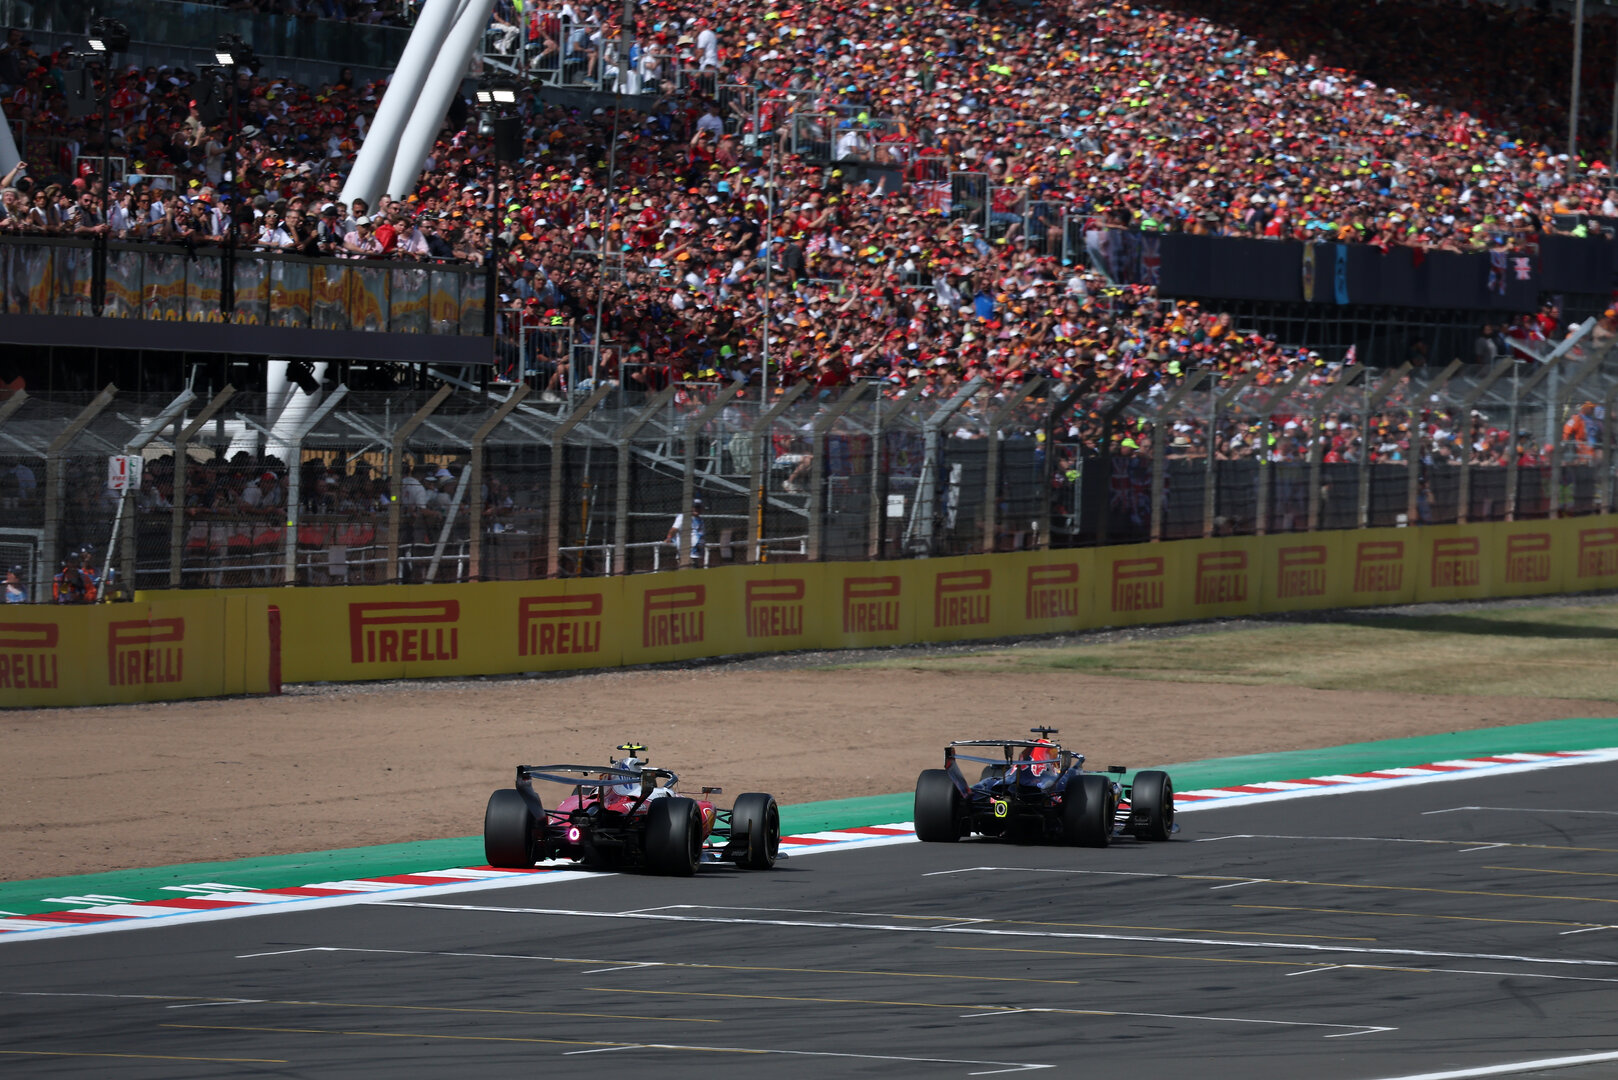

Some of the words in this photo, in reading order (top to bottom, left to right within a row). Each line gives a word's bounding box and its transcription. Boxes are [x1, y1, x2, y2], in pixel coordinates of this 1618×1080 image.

[1113, 558, 1162, 610] PIRELLI
[1196, 551, 1246, 603] PIRELLI
[1278, 547, 1326, 597] PIRELLI
[1355, 541, 1402, 591] PIRELLI
[1432, 537, 1479, 585] PIRELLI
[1507, 533, 1550, 581] PIRELLI
[644, 586, 705, 646] PIRELLI
[747, 580, 804, 635] PIRELLI
[844, 577, 901, 631] PIRELLI
[936, 570, 991, 626] PIRELLI
[1027, 564, 1078, 618] PIRELLI
[109, 617, 183, 685] PIRELLI
[349, 600, 459, 662] PIRELLI
[518, 594, 602, 655] PIRELLI
